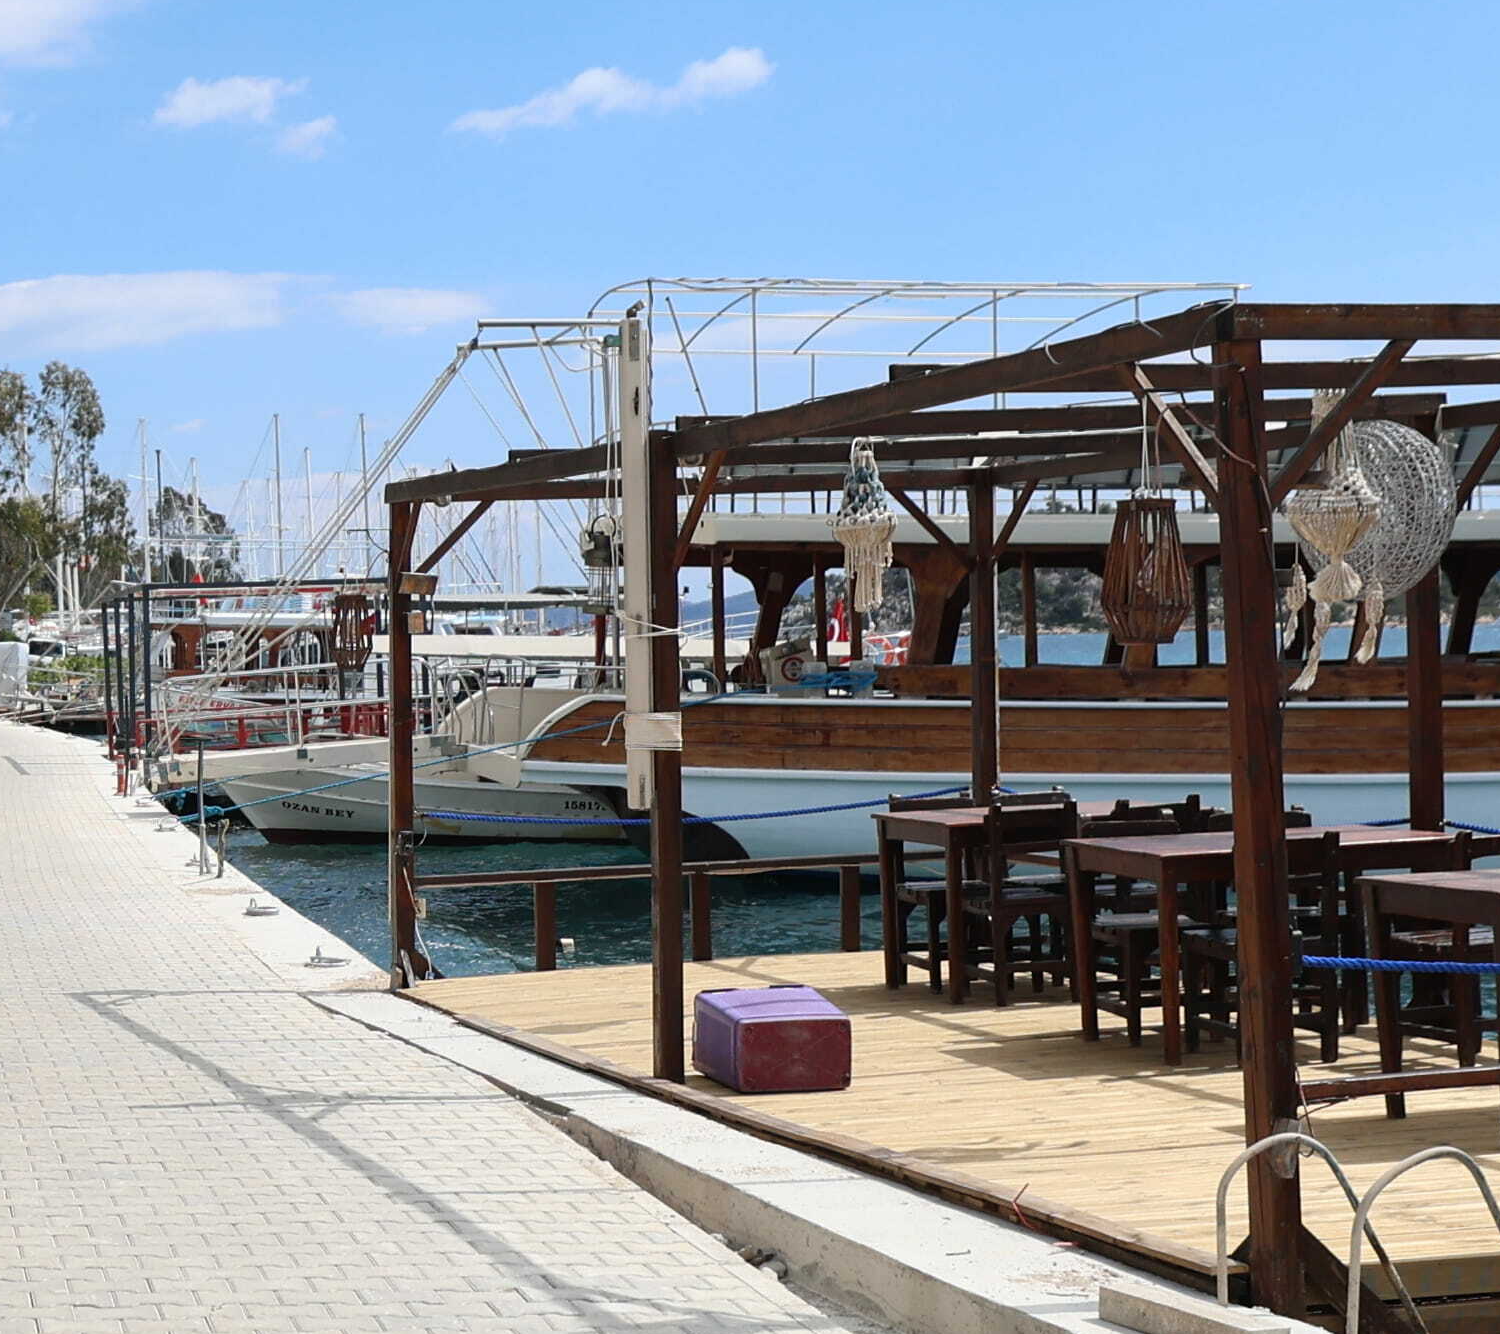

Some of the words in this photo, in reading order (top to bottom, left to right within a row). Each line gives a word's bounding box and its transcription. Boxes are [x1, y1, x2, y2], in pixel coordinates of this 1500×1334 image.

[281, 800, 320, 815] OZAN
[325, 807, 355, 819] BEY
[564, 800, 606, 812] 15817
